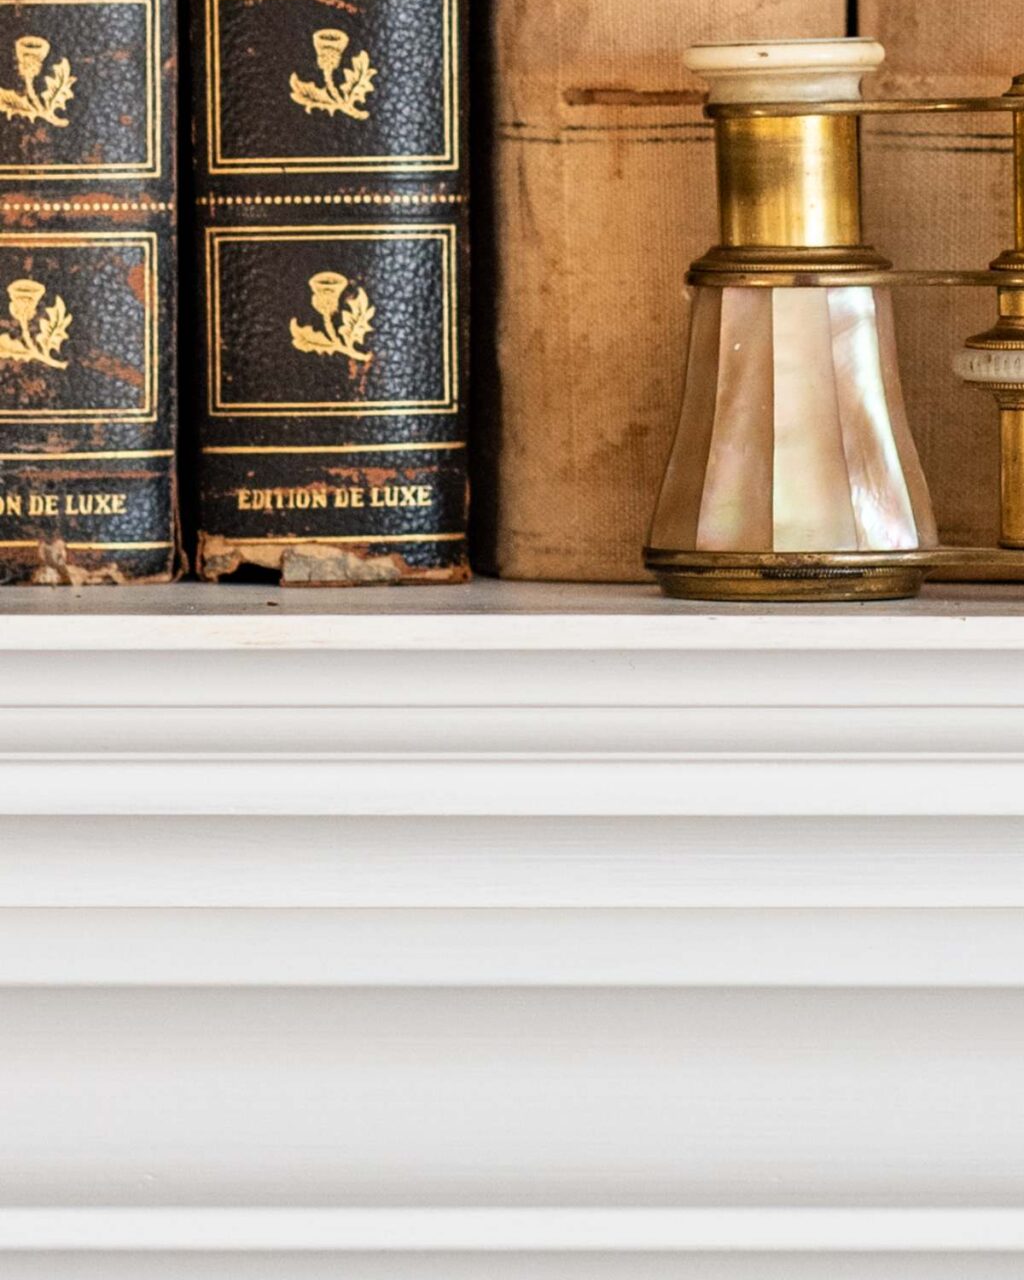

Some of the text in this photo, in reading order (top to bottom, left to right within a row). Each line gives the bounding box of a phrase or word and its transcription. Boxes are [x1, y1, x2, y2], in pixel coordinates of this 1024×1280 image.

[28, 493, 59, 516] DE
[65, 493, 128, 516] LUXE
[237, 485, 433, 510] EDITION DE LUXE
